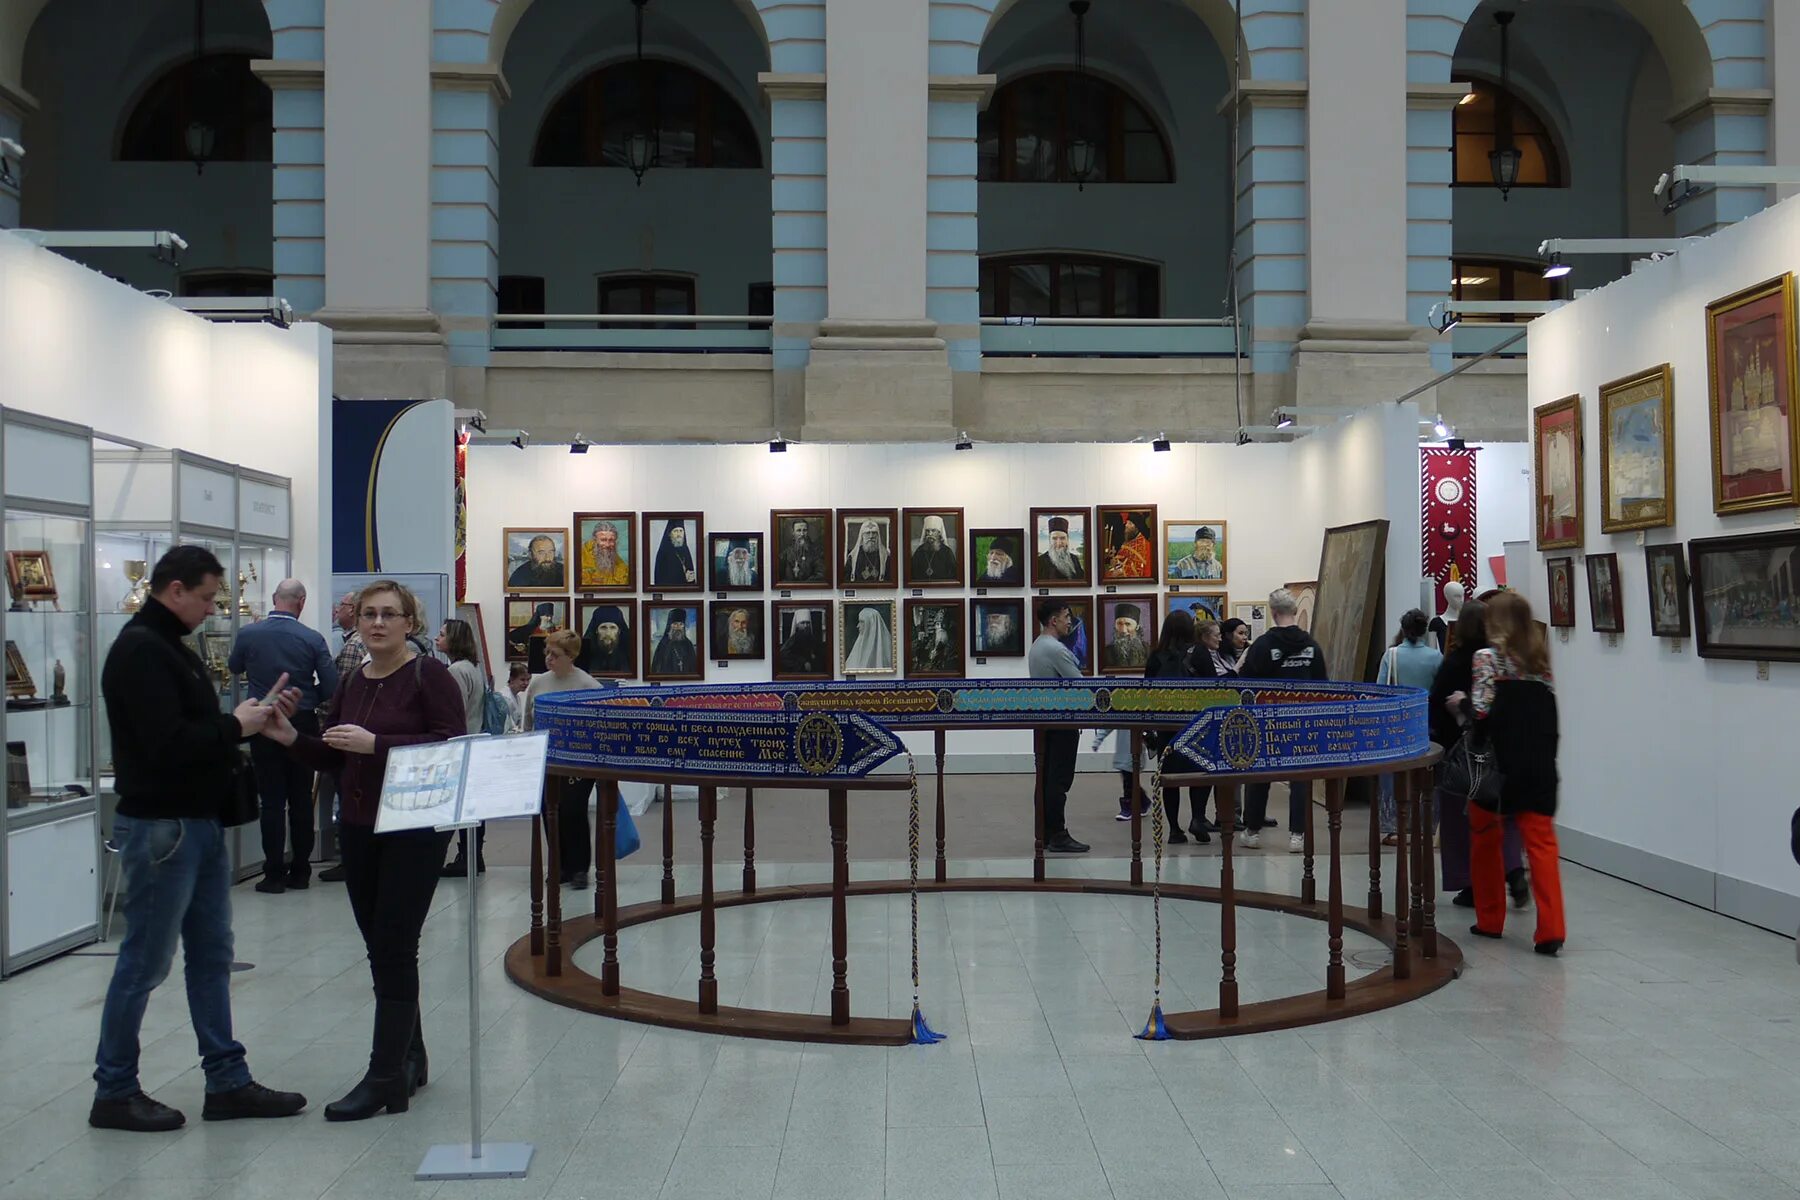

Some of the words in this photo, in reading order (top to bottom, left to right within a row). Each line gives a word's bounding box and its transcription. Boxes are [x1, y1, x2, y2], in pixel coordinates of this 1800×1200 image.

[691, 724, 713, 733] беса
[1307, 731, 1319, 740] от
[677, 735, 699, 747] всех
